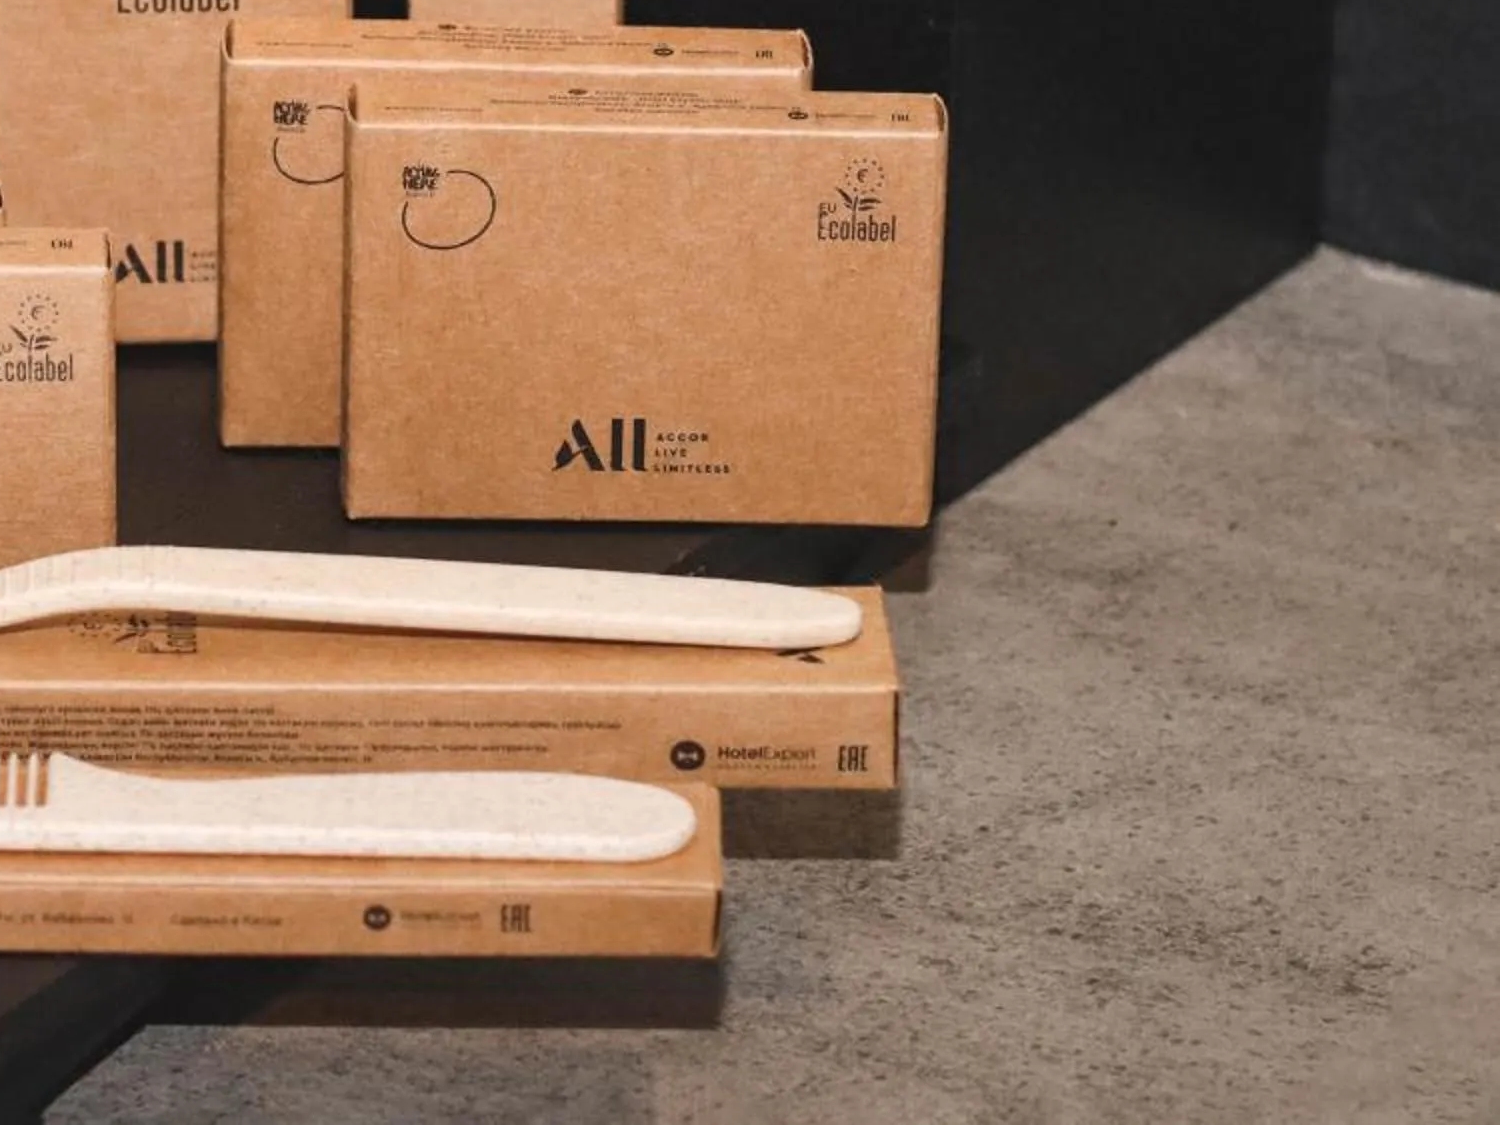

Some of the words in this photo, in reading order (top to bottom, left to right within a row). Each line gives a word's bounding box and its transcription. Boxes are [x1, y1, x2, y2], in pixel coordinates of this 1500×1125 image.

[818, 212, 897, 242] Ecolabel
[656, 433, 708, 442] ACCOR
[655, 448, 687, 458] LIVE
[653, 464, 731, 474] LIMITLESS
